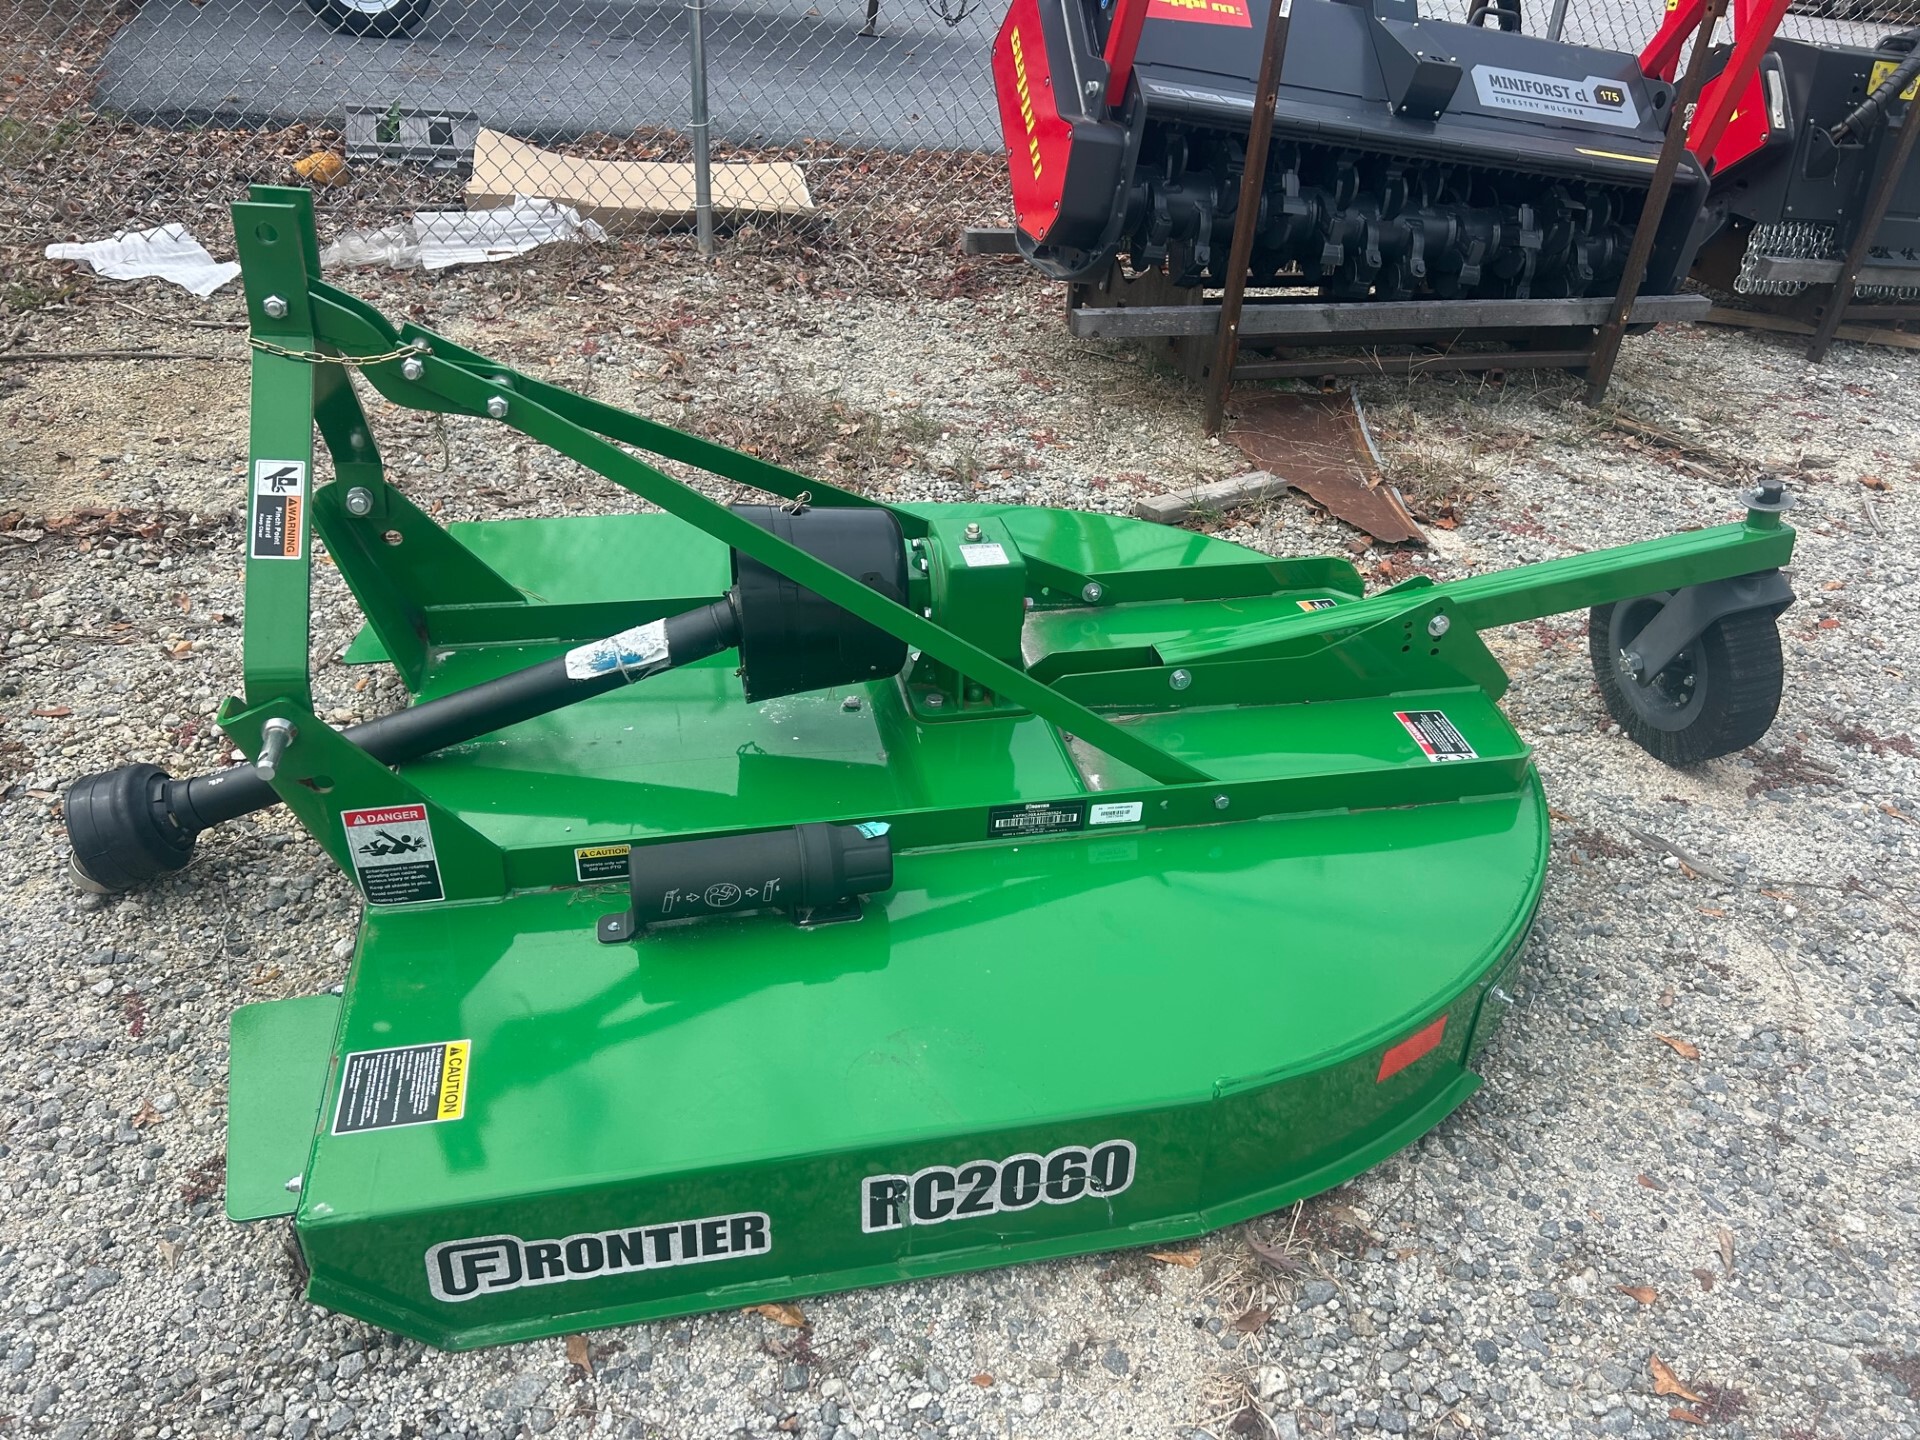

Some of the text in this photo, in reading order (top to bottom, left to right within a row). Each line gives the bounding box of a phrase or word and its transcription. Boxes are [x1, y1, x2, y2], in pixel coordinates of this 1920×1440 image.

[1489, 74, 1589, 102] MINIFORST cl
[1600, 90, 1620, 103] 175
[1495, 97, 1584, 116] FORESTRY MULCHER
[265, 514, 273, 539] Hazard
[274, 506, 283, 545] Pinch Point
[286, 507, 297, 553] WARNING
[367, 810, 419, 823] DANGER
[589, 847, 627, 856] CAUTION
[443, 1058, 462, 1113] CAUTION
[868, 1144, 1132, 1231] RC2060
[436, 1217, 766, 1298] FRONTIER
